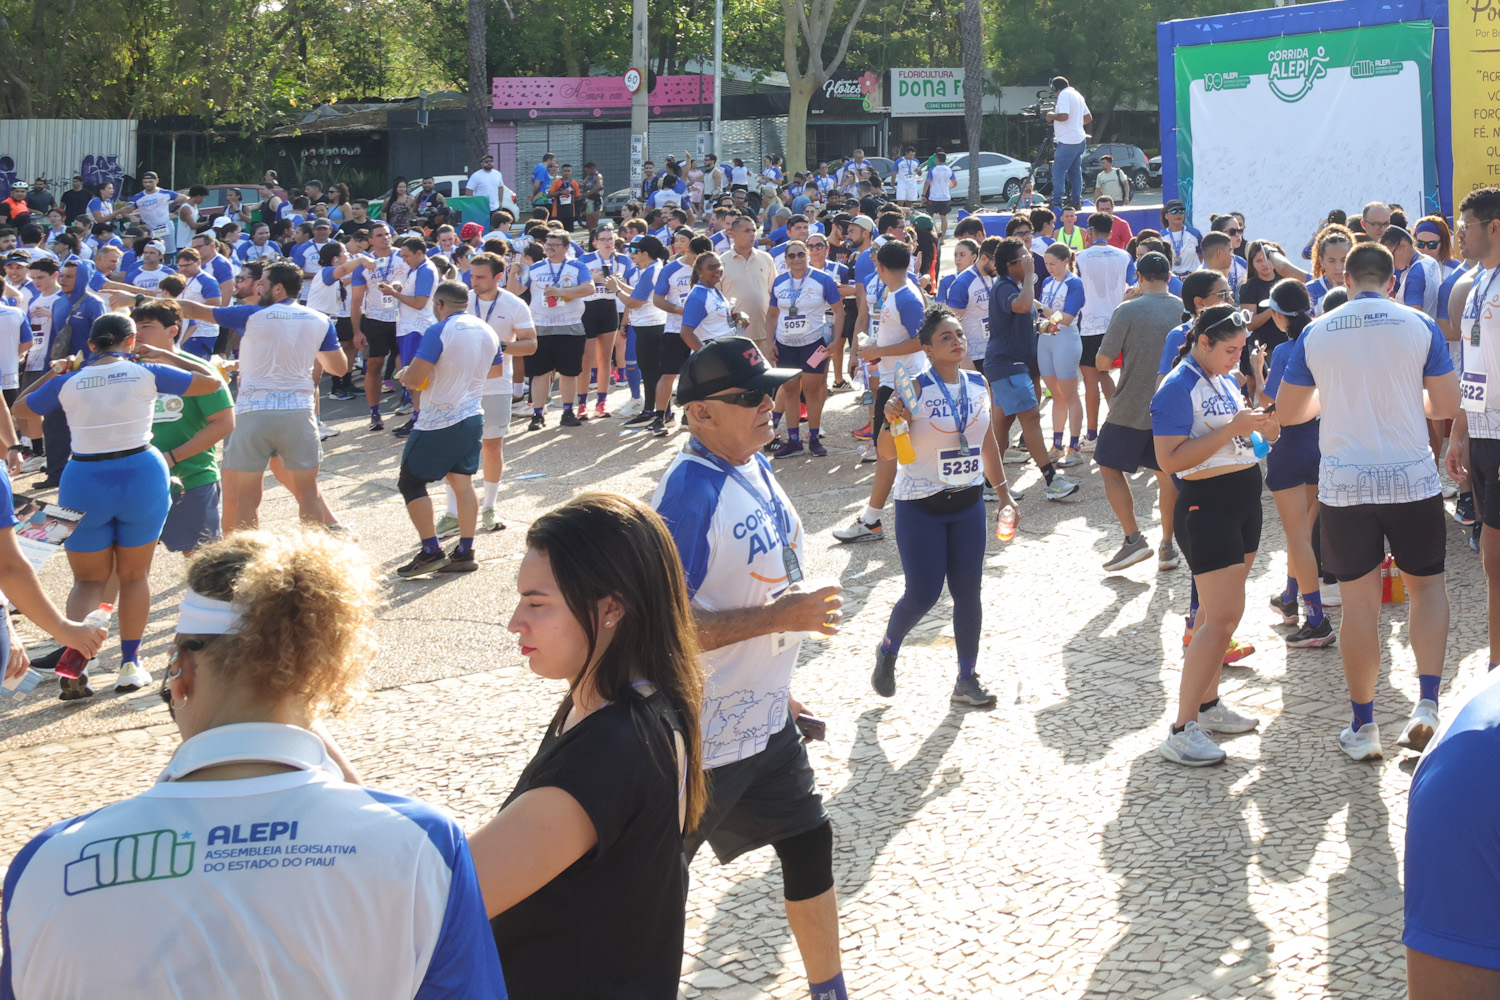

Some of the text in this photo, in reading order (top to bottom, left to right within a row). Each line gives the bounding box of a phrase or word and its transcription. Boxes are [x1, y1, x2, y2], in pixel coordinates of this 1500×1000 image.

[1476, 29, 1490, 37] Por
[1268, 48, 1309, 62] CORRIDA
[1375, 58, 1391, 66] ALEPI
[898, 70, 954, 79] FLORICULTURA
[1222, 71, 1239, 80] ALEPI
[1269, 60, 1309, 79] ALEPI
[627, 74, 638, 84] 60
[1204, 72, 1223, 90] 190
[823, 79, 862, 98] Flores
[1474, 125, 1489, 138] FÉ.
[371, 269, 395, 280] ALPI
[1364, 312, 1388, 320] ALEPI
[784, 320, 806, 329] 5057
[929, 403, 973, 419] ALI
[1203, 402, 1239, 417] ALEP
[942, 458, 979, 476] 5238
[747, 509, 791, 566] ALI
[207, 820, 298, 846] ALEPI
[204, 844, 357, 860] ASSEMBLEIA LEGISLATIVA
[203, 855, 337, 873] DO ESTADO DO PIAUÍ
